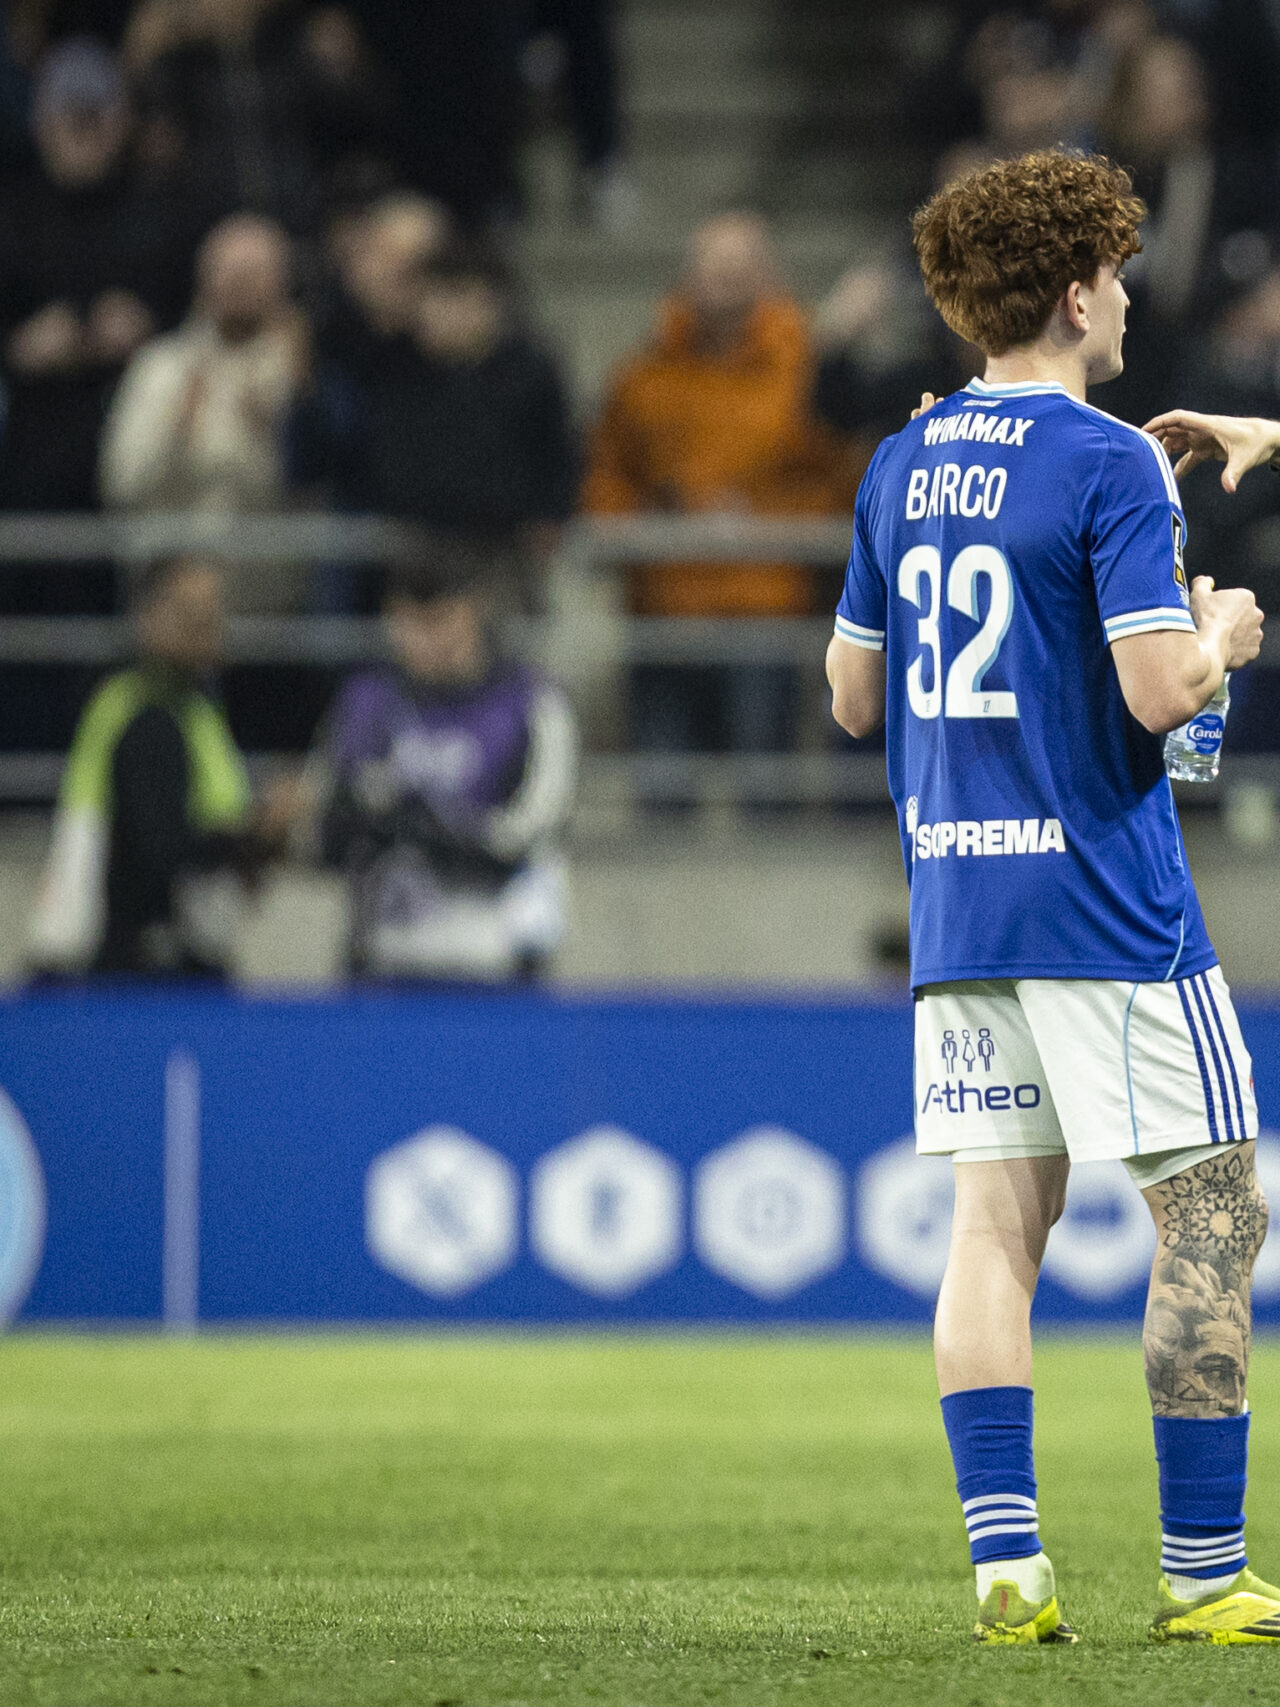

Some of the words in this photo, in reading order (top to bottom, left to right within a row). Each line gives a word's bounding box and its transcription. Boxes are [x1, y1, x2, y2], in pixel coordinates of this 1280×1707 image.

[924, 413, 1034, 446] WINAMAX
[906, 463, 1008, 520] BARCO
[897, 544, 1020, 719] 32
[917, 818, 1066, 860] SOPREMA
[923, 1080, 1041, 1114] Atheo
